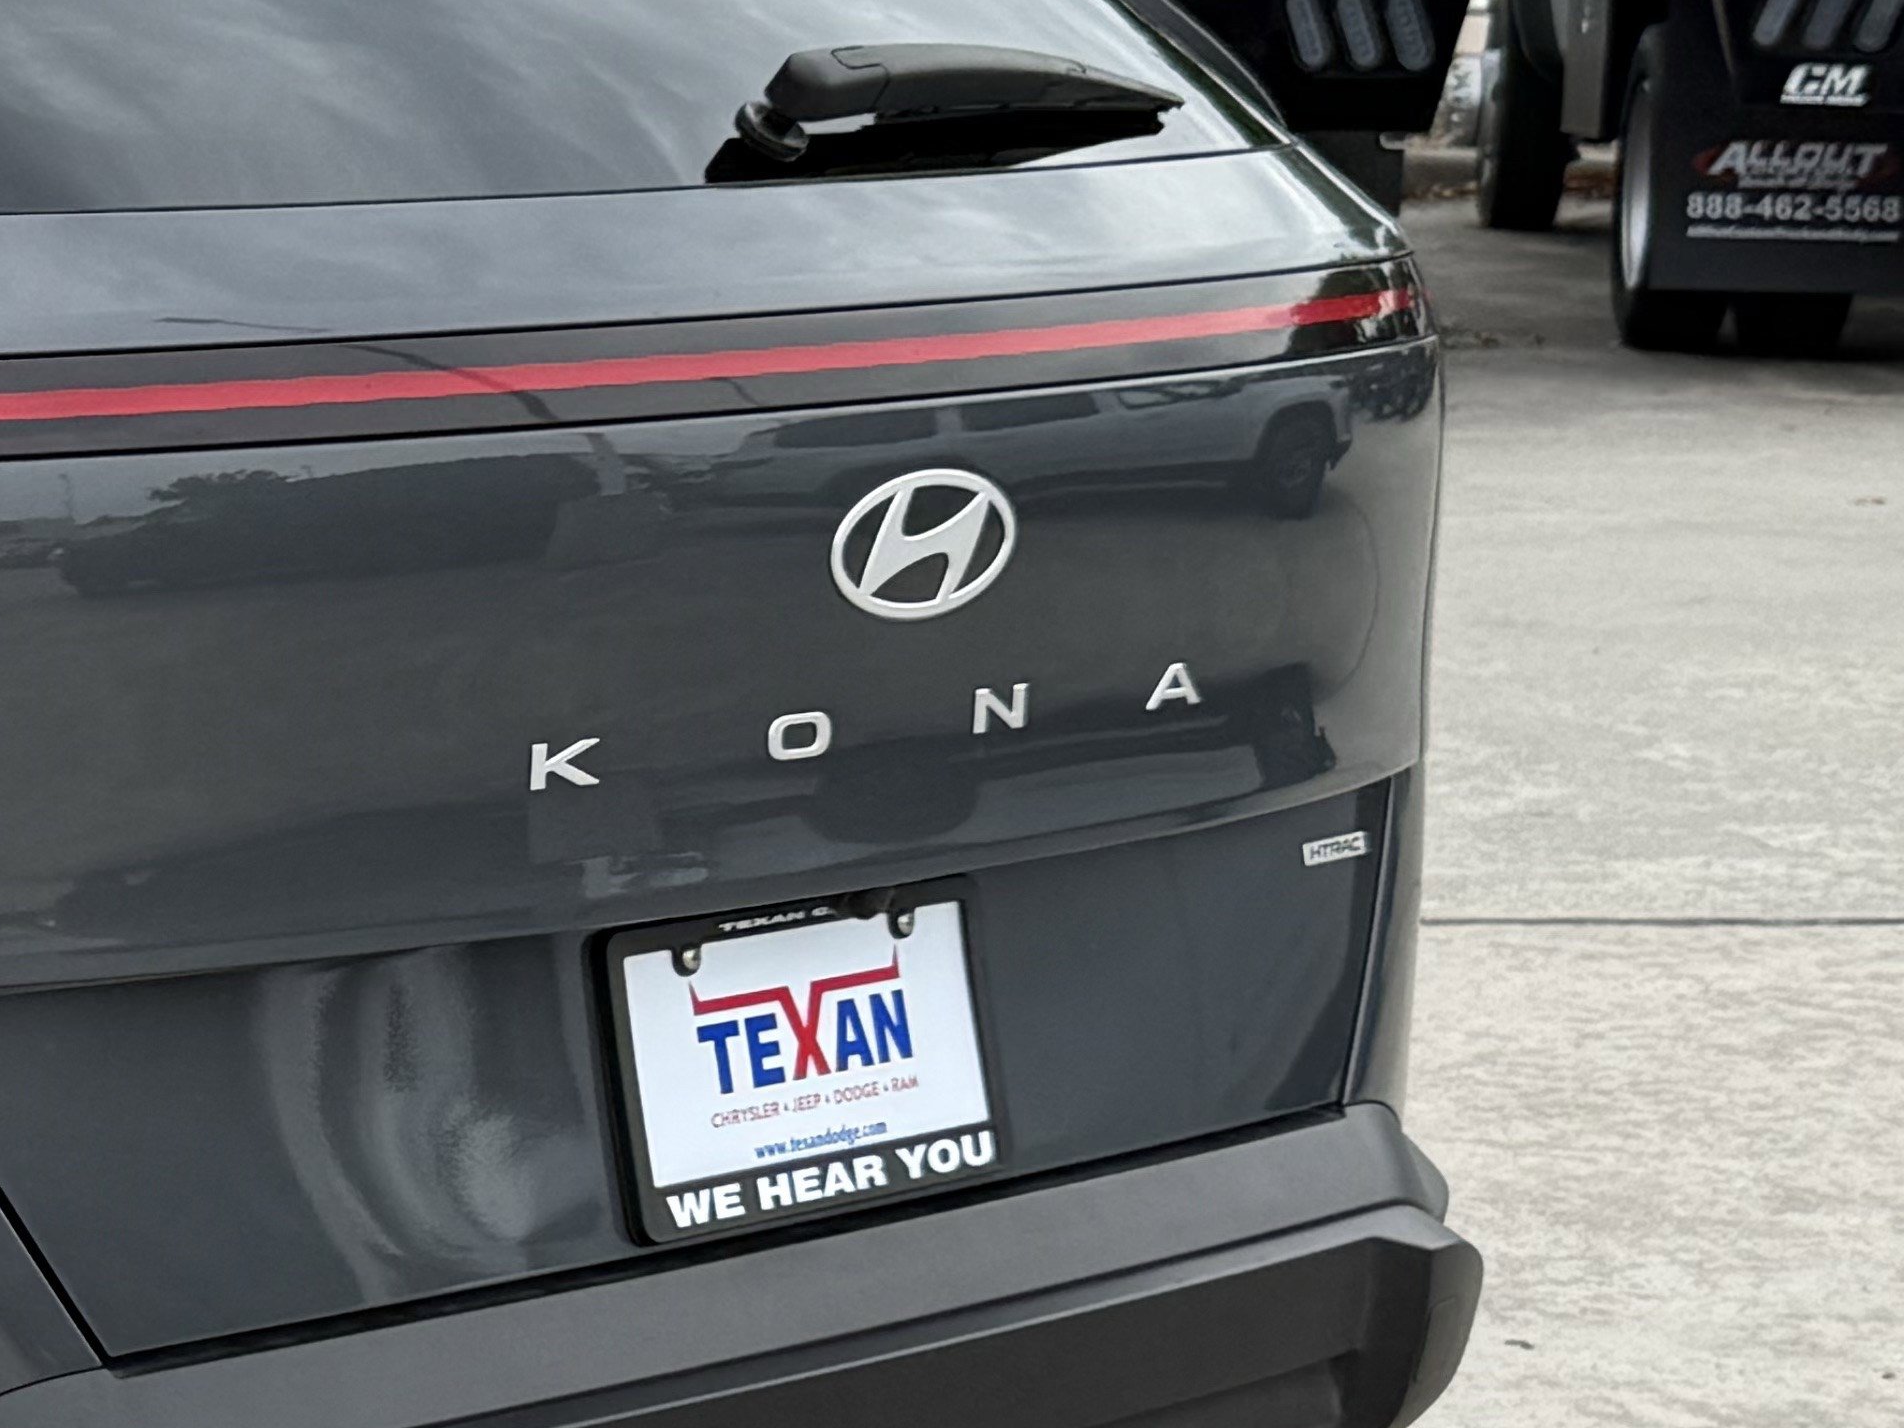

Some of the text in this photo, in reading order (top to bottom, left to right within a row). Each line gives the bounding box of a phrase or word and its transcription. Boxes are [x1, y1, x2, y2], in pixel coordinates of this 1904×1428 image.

[530, 662, 1203, 792] KONA
[718, 910, 806, 932] TEXAN
[689, 952, 914, 1096] TEXAN
[711, 1074, 920, 1129] CHRYSLER JEEP DODGE RAM
[665, 1130, 995, 1228] WE HEAR YOU
